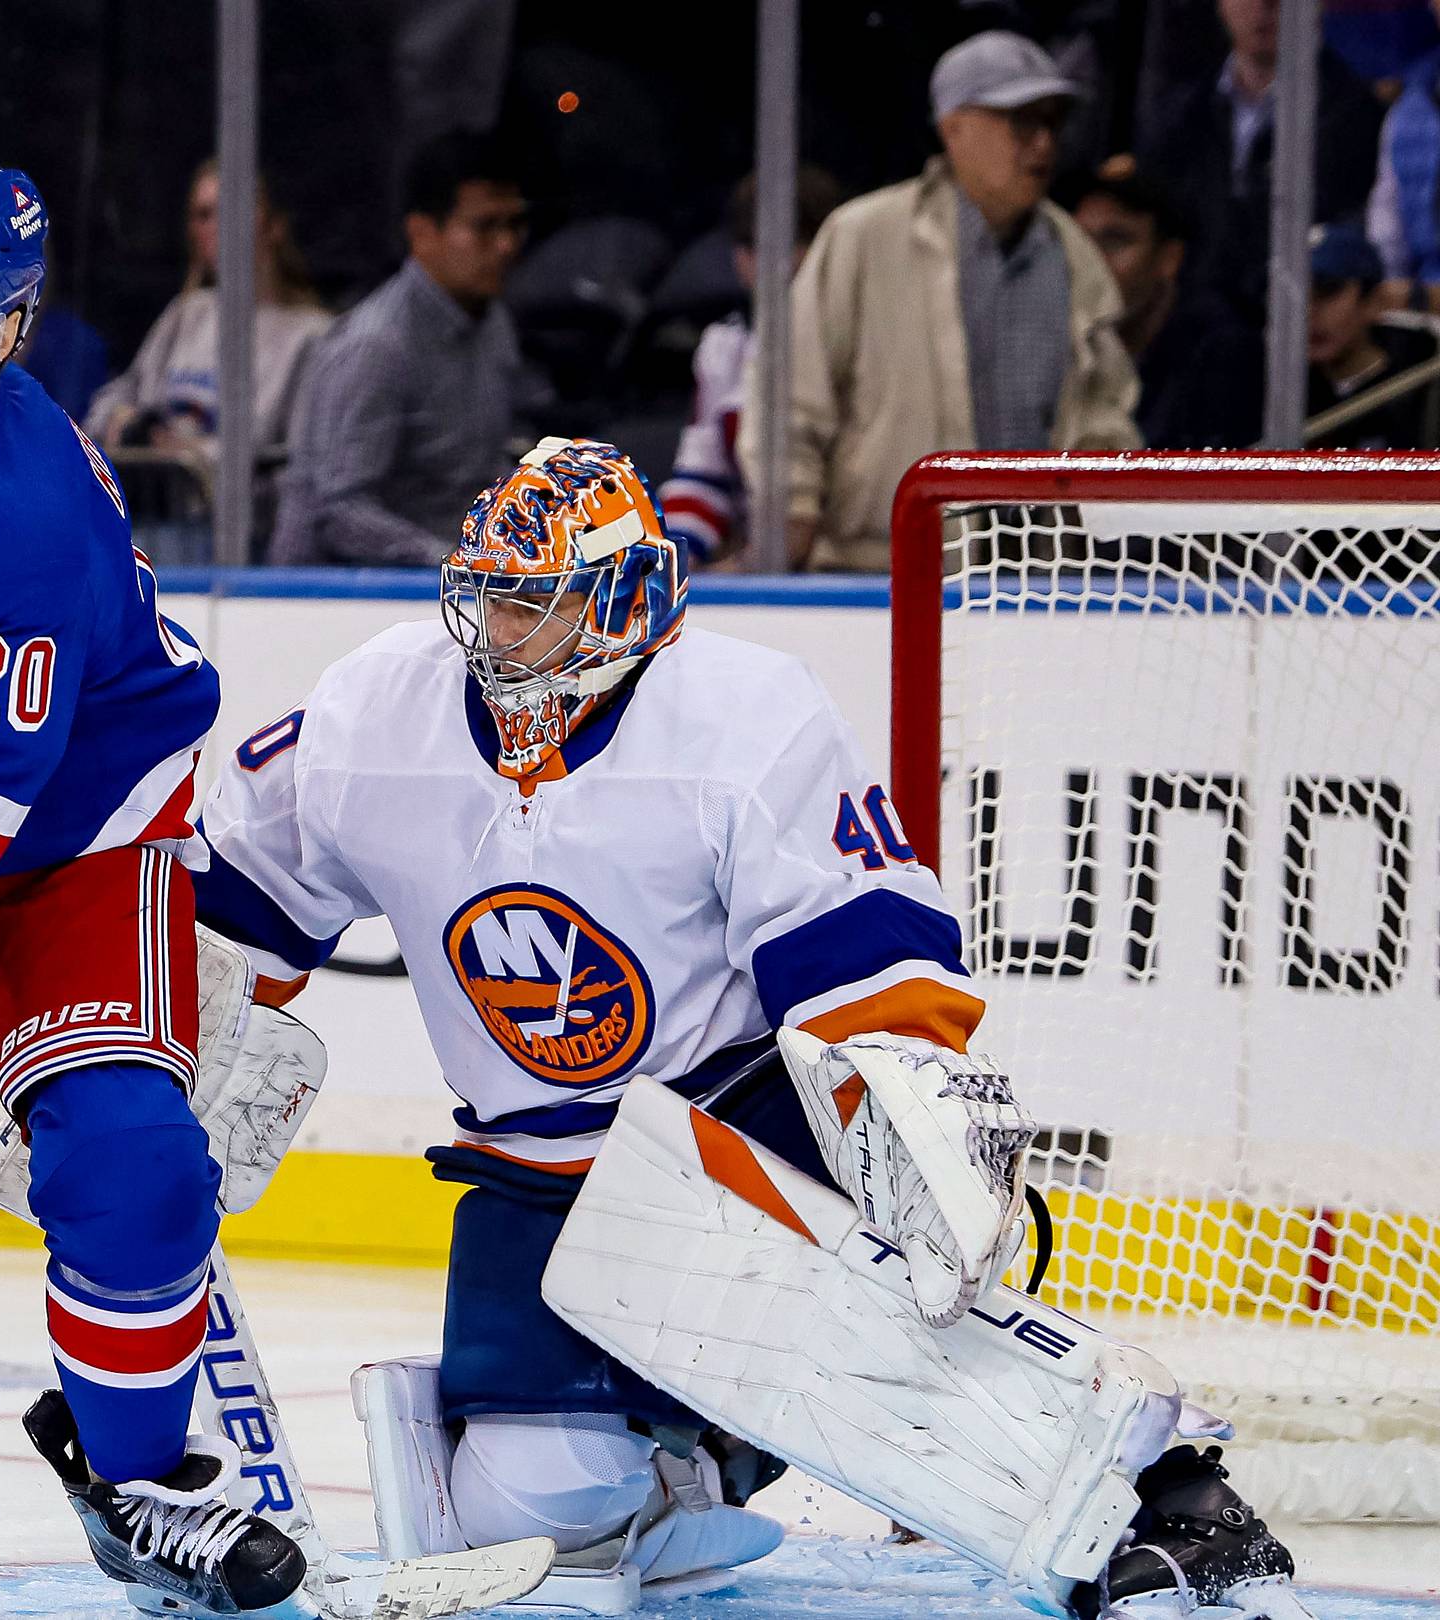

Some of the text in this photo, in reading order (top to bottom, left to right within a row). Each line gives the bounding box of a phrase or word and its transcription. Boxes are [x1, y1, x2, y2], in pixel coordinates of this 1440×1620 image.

[10, 201, 42, 230] Benjamin
[19, 217, 42, 241] Moore
[830, 784, 917, 871] 40
[484, 1002, 628, 1067] ISLANDERS
[858, 1230, 1078, 1361] TUE
[203, 1262, 295, 1518] AUER
